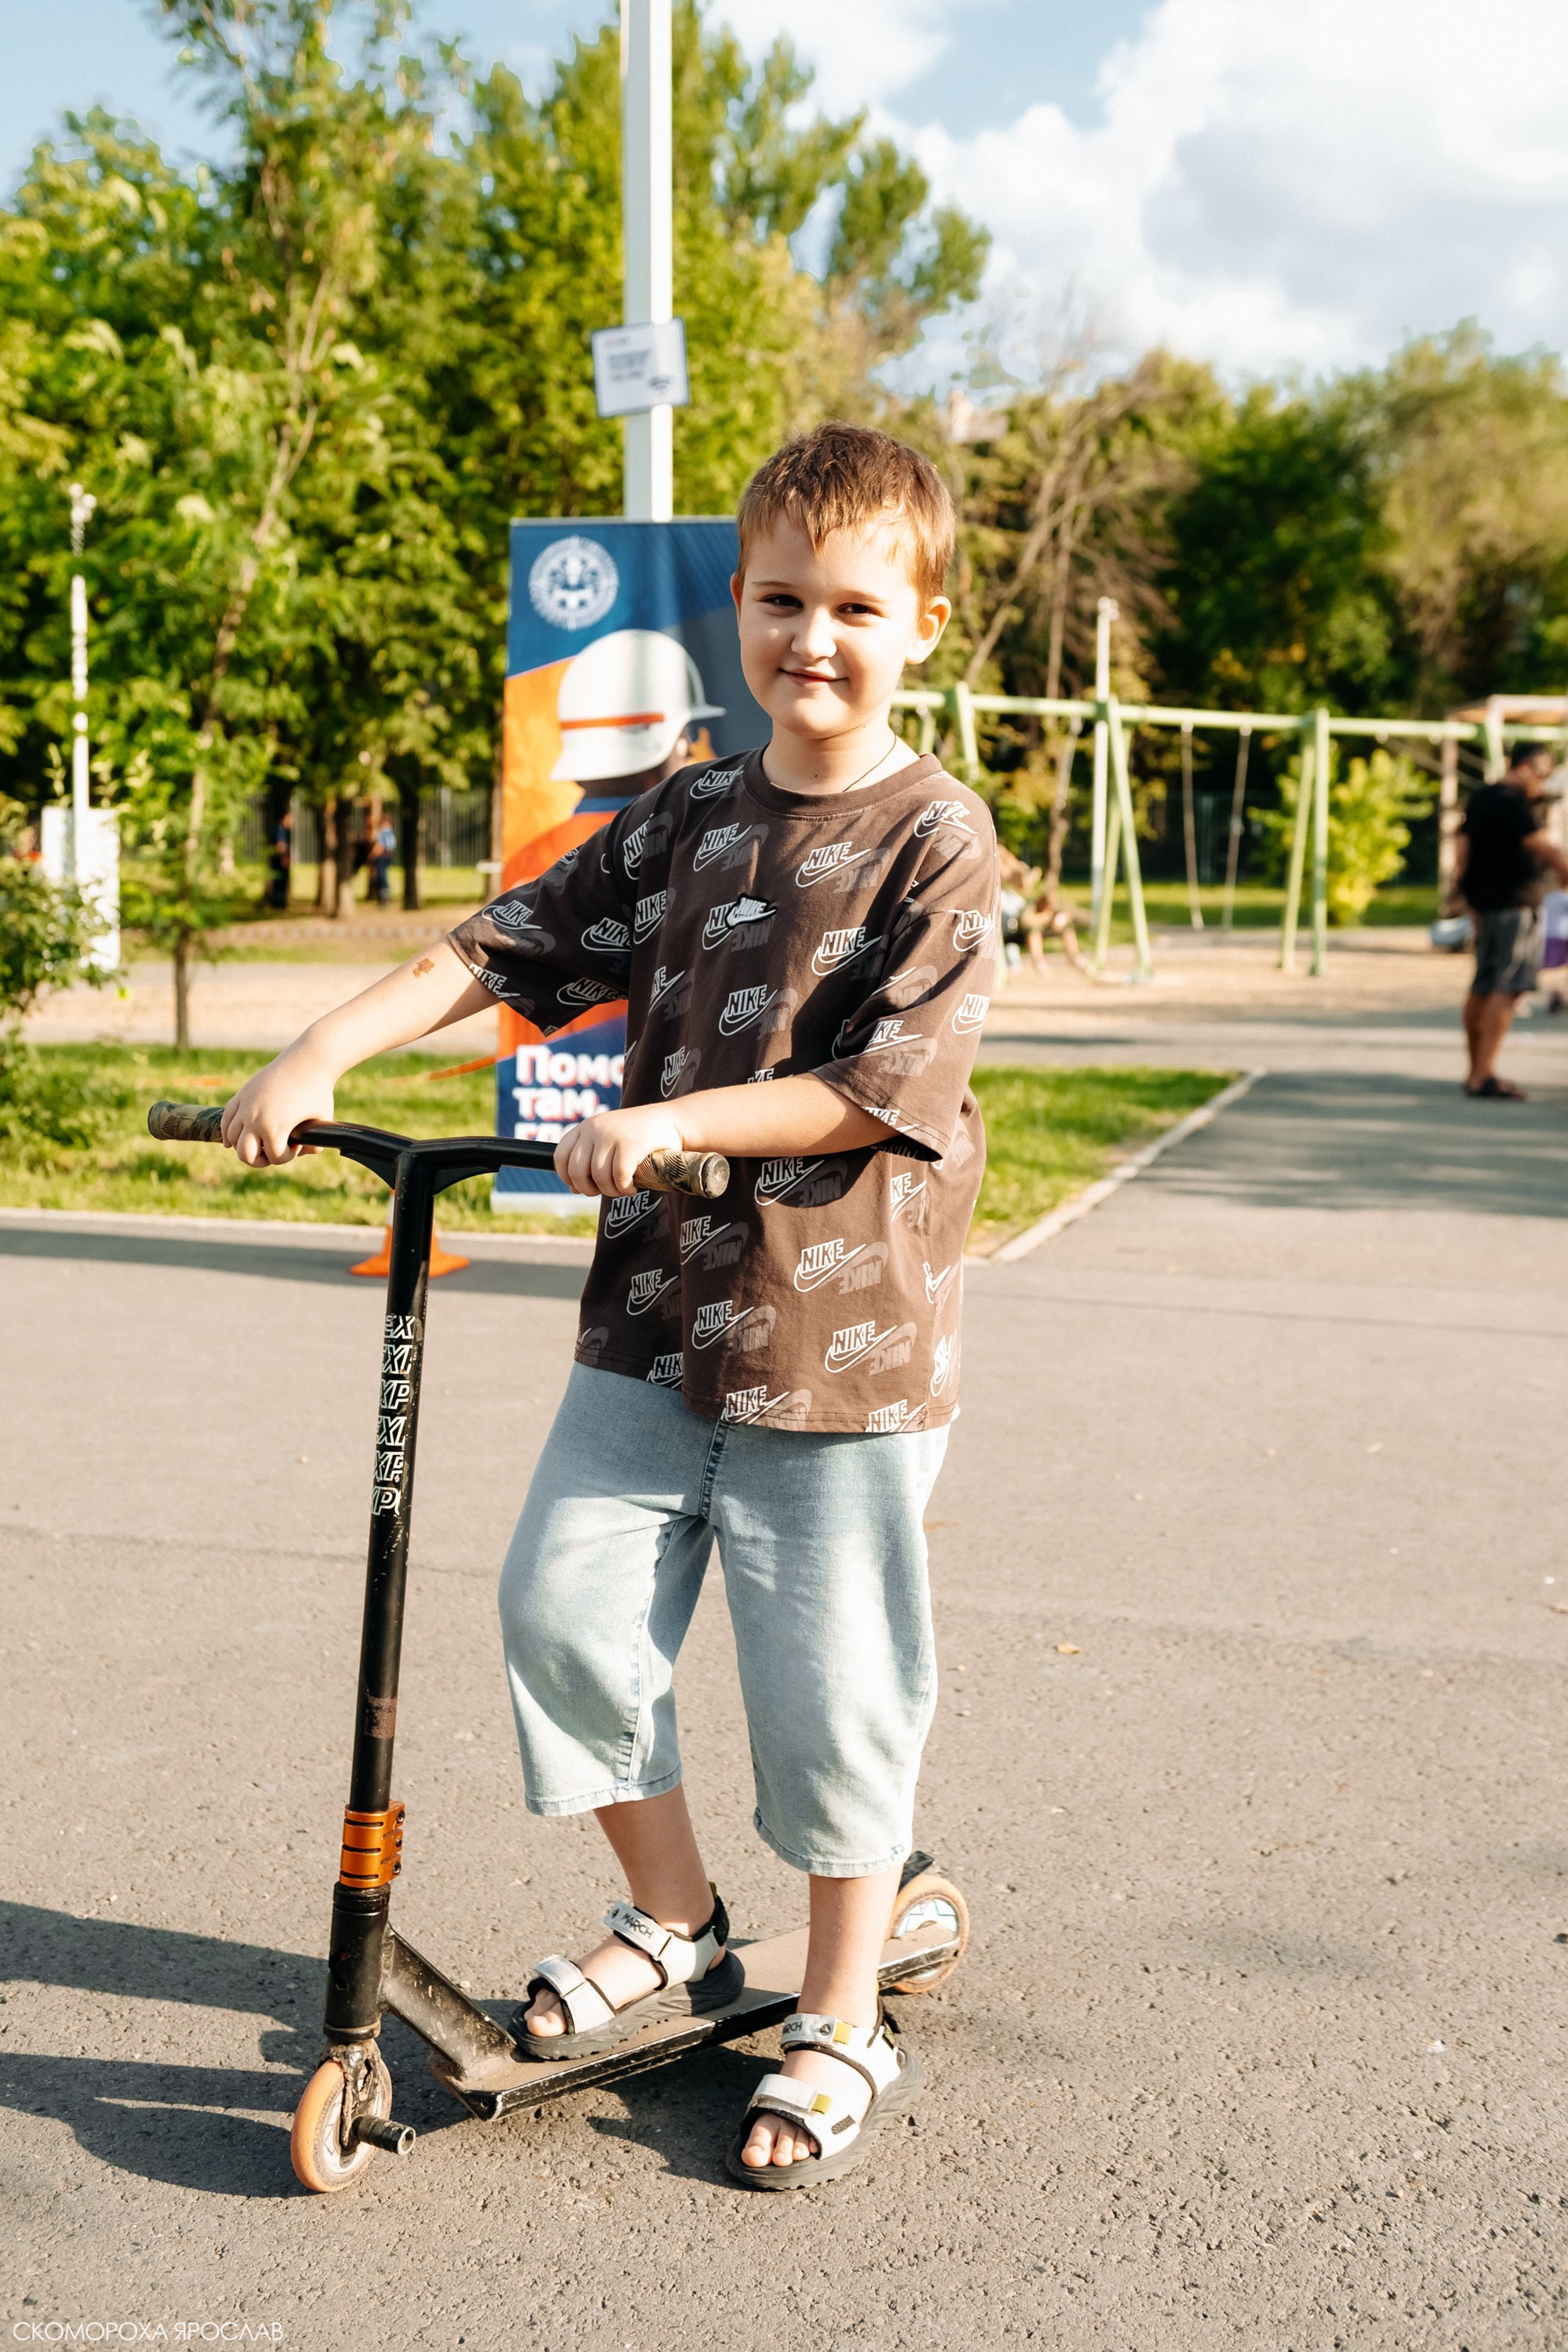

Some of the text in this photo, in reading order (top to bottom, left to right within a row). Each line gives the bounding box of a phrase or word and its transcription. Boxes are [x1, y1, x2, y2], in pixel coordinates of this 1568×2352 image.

[623, 822, 650, 863] NIK
[700, 822, 740, 853] NIKE
[805, 841, 853, 869] NIKE
[497, 900, 534, 926] NIKE
[636, 890, 667, 926] NIKE
[736, 897, 768, 917] NIKE
[820, 927, 866, 956] NIKE
[728, 985, 768, 1018] NIKE
[960, 993, 991, 1019] NIKE
[760, 1156, 804, 1187] NIKE
[609, 1189, 651, 1221] NIKE
[799, 1176, 842, 1208] NIKE
[680, 1215, 712, 1247] NIKE
[703, 1240, 742, 1272] NIKE
[800, 1238, 844, 1274] NIKE
[631, 1269, 663, 1299] NIKE
[838, 1260, 883, 1295] NIKE
[697, 1300, 734, 1332] NIKE
[832, 1320, 877, 1356] NIKE
[652, 1352, 684, 1380] NIK
[869, 1339, 912, 1376] NIKE
[724, 1385, 768, 1418] NIKE
[866, 1399, 908, 1433] NIKE
[621, 1912, 655, 1939] MARCH
